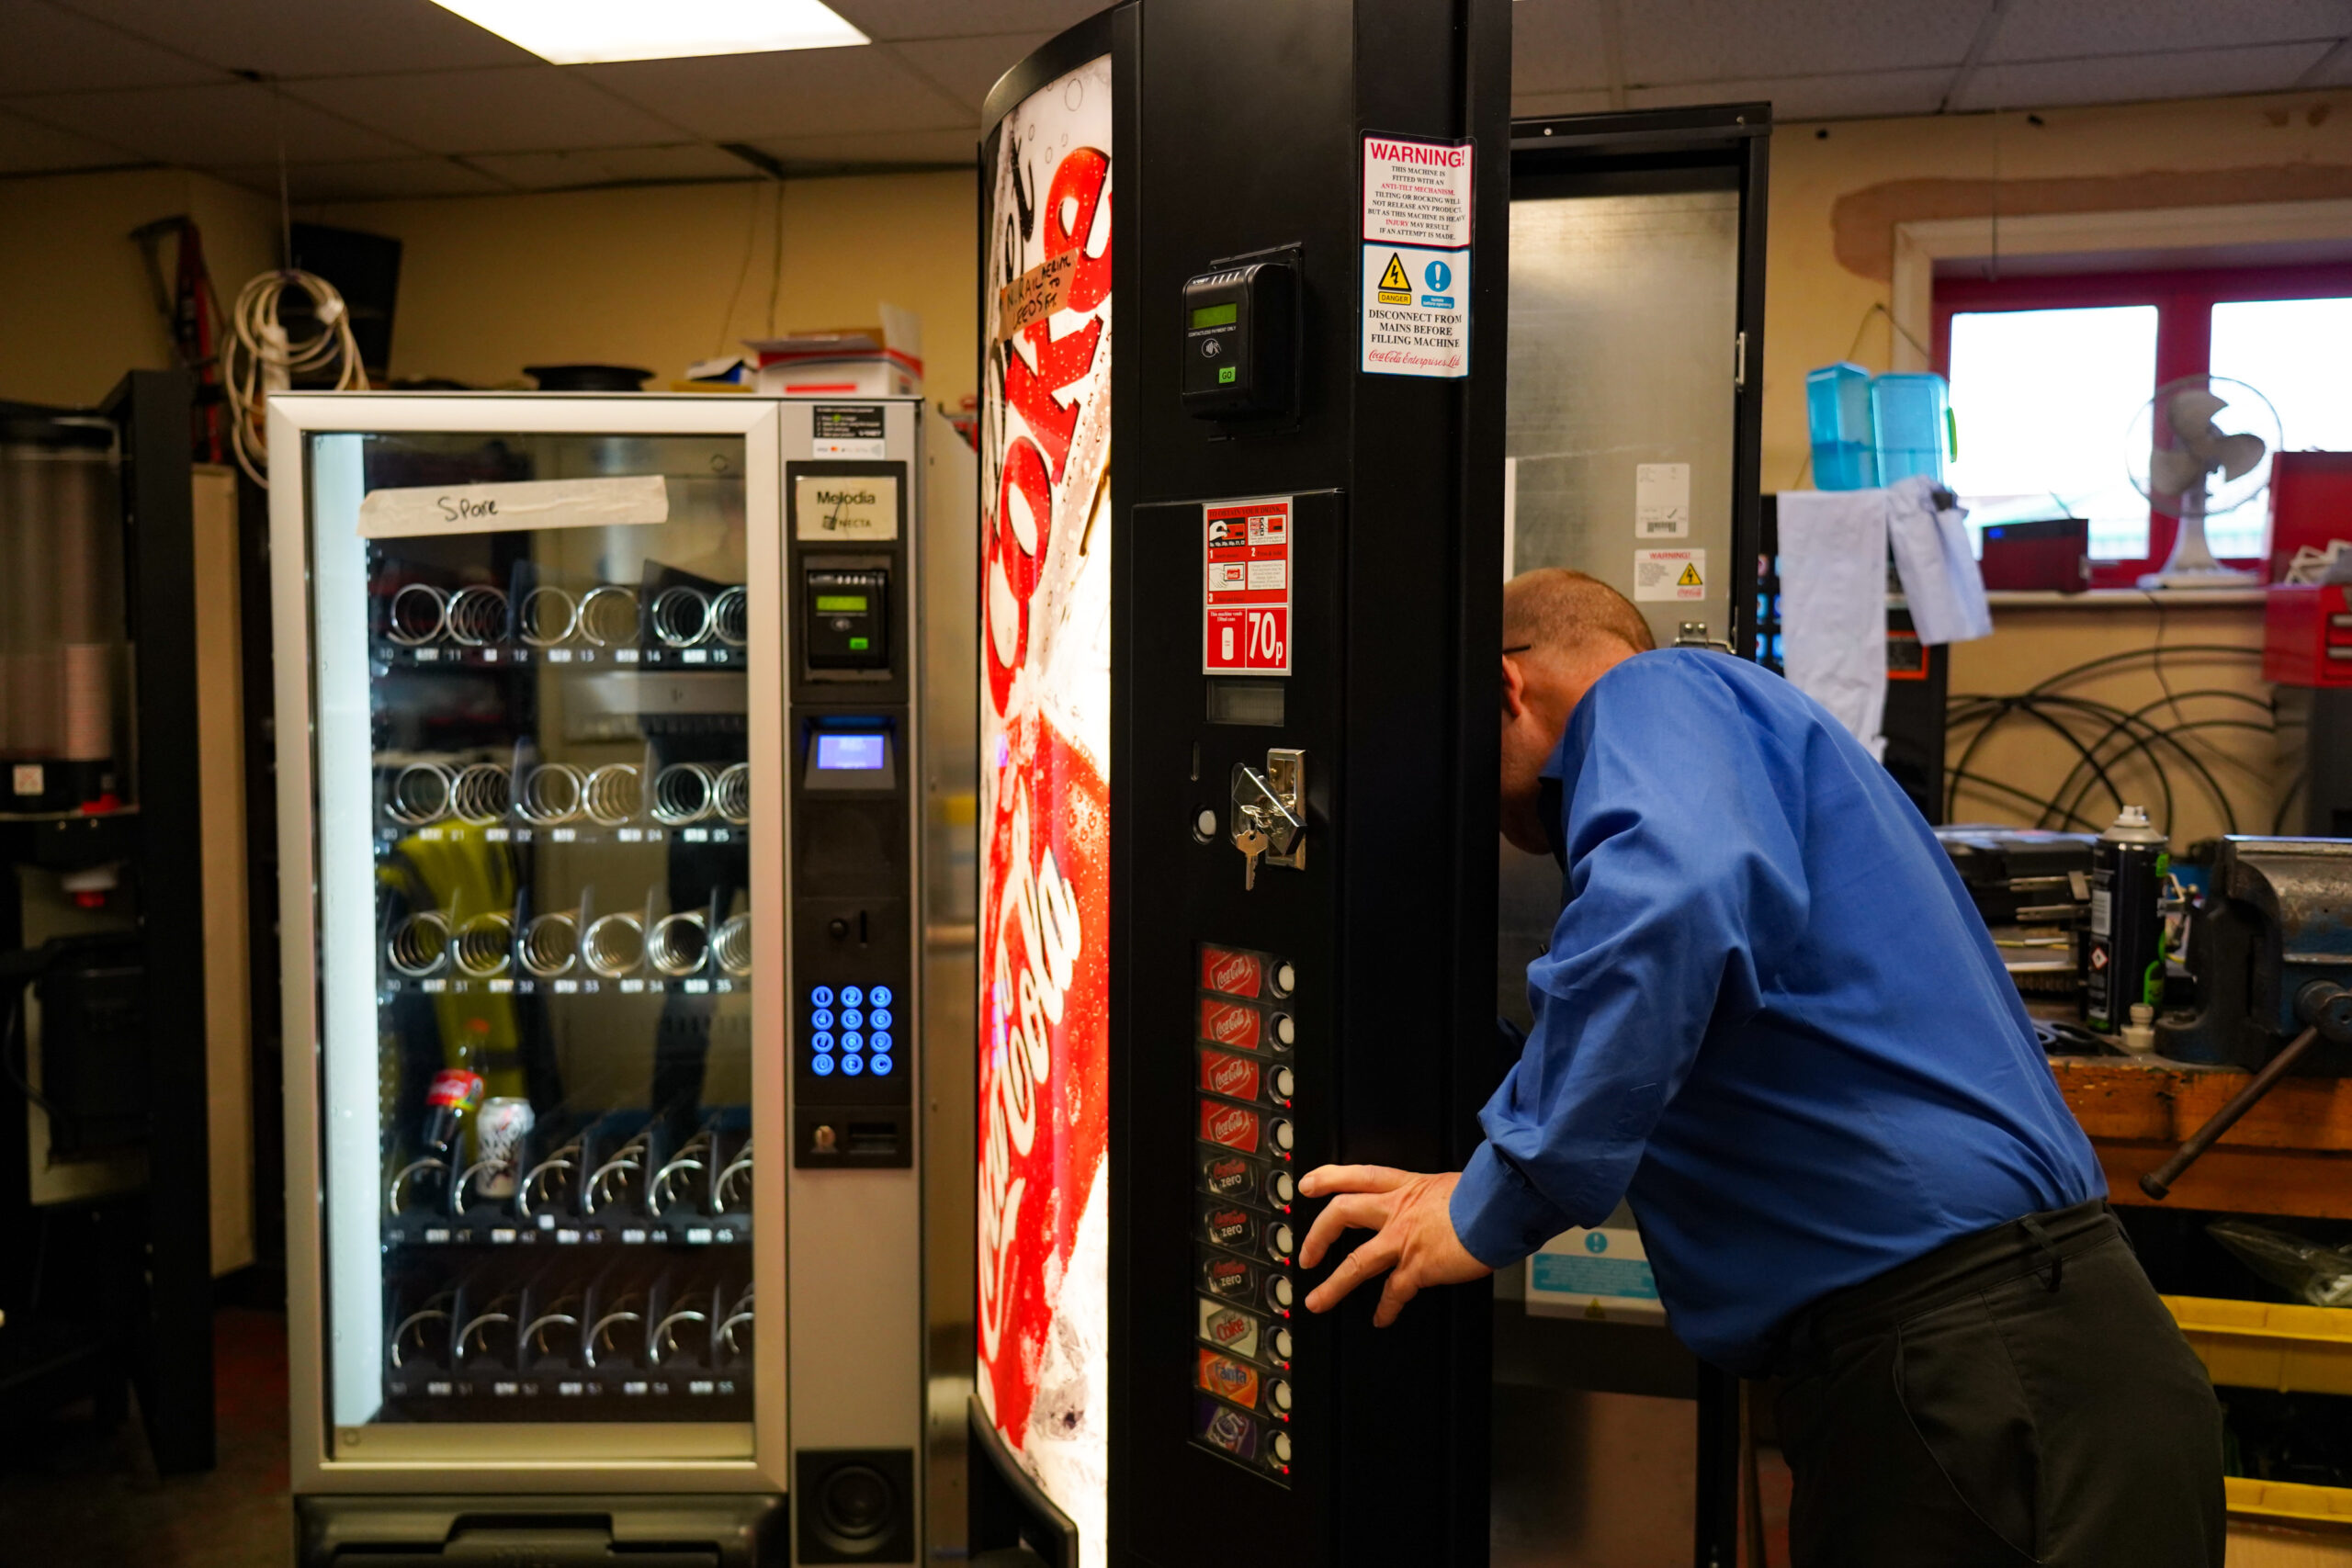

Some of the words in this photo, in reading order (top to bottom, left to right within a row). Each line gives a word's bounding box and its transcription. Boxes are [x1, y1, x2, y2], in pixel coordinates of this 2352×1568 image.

[1371, 142, 1464, 167] WARNING!
[1408, 167, 1439, 176] MACHINE
[1392, 175, 1415, 183] FITTED
[1381, 183, 1413, 191] ANTI-TILT
[1373, 199, 1385, 208] NOT
[1387, 201, 1416, 209] RELEASE
[1374, 191, 1401, 200] TILTING
[1413, 195, 1443, 204] ROCKING
[1385, 219, 1409, 227] INJURY
[1426, 222, 1450, 231] RESULT
[1381, 294, 1408, 303] DANGER
[1369, 309, 1431, 323] DISCONNECT
[1434, 314, 1463, 324] FROM
[1379, 322, 1411, 333] MAINS
[1413, 325, 1453, 336] BEFORE
[1371, 333, 1411, 345] FILLING
[1413, 336, 1460, 348] MACHINE
[1402, 351, 1447, 368] Enterprises
[1447, 354, 1462, 368] Ltd
[1222, 371, 1232, 380] GO
[981, 145, 1112, 721] Coke
[817, 491, 876, 505] Melodia
[437, 496, 498, 522] Spare
[1209, 549, 1213, 558] 1
[1251, 547, 1256, 557] 2
[1648, 552, 1690, 560] WARNING!
[1209, 593, 1213, 603] 3
[1250, 612, 1283, 666] 70p
[380, 648, 393, 660] 10
[448, 649, 461, 660] 11
[514, 649, 527, 661] 12
[647, 649, 662, 662] 14
[713, 649, 728, 663] 15
[1217, 956, 1245, 989] Coca-Cola
[1216, 1008, 1244, 1040] Coca-Cola
[978, 774, 1081, 1363] Coca-Cola
[1216, 1059, 1243, 1089] Coca-Cola
[1216, 1110, 1243, 1140] Coca-Cola
[1220, 1174, 1242, 1188] zero
[1221, 1224, 1242, 1237] zero
[1220, 1273, 1242, 1287] zero
[1216, 1318, 1245, 1342] Coke
[1215, 1363, 1247, 1384] Fanta
